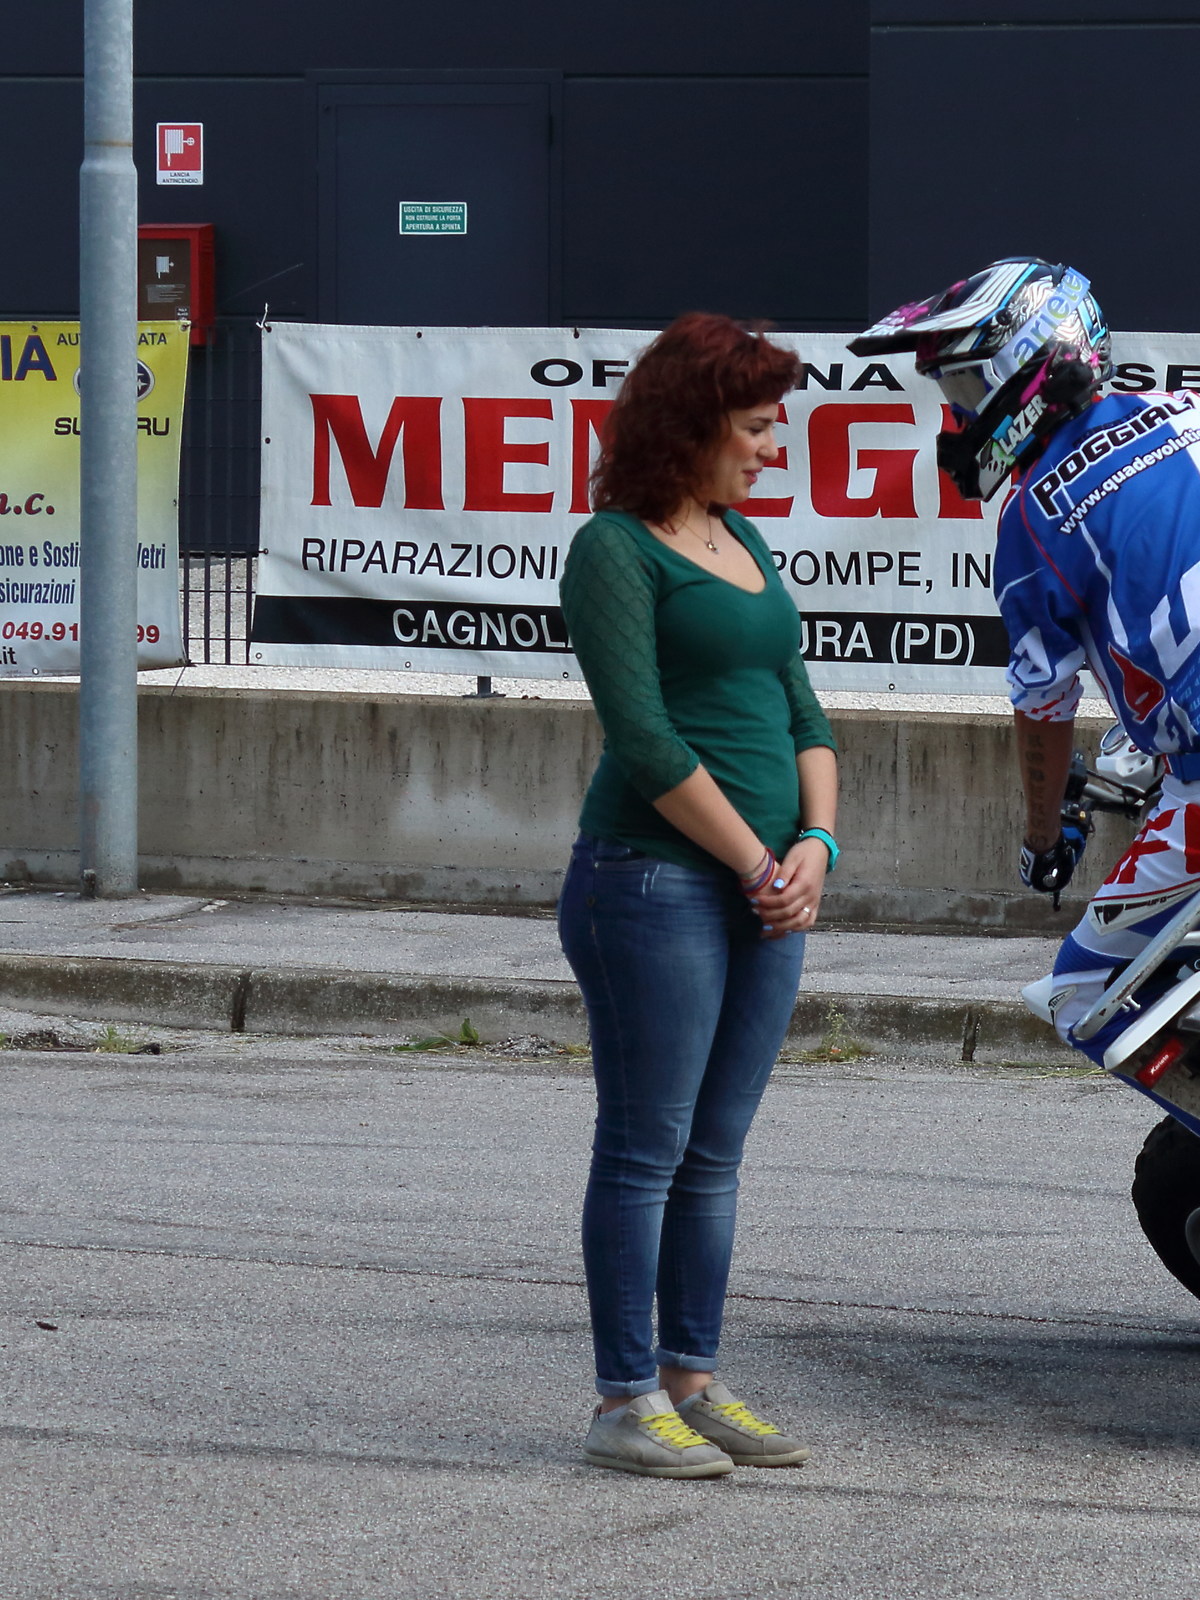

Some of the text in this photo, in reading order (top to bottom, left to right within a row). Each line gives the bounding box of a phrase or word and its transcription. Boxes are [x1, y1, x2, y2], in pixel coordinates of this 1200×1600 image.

[0, 335, 57, 381] IA
[999, 394, 1049, 456] LAZER
[29, 545, 38, 567] e
[43, 540, 81, 568] Sosti
[301, 537, 559, 581] RIPARAZIONI
[890, 620, 976, 667] (PD)
